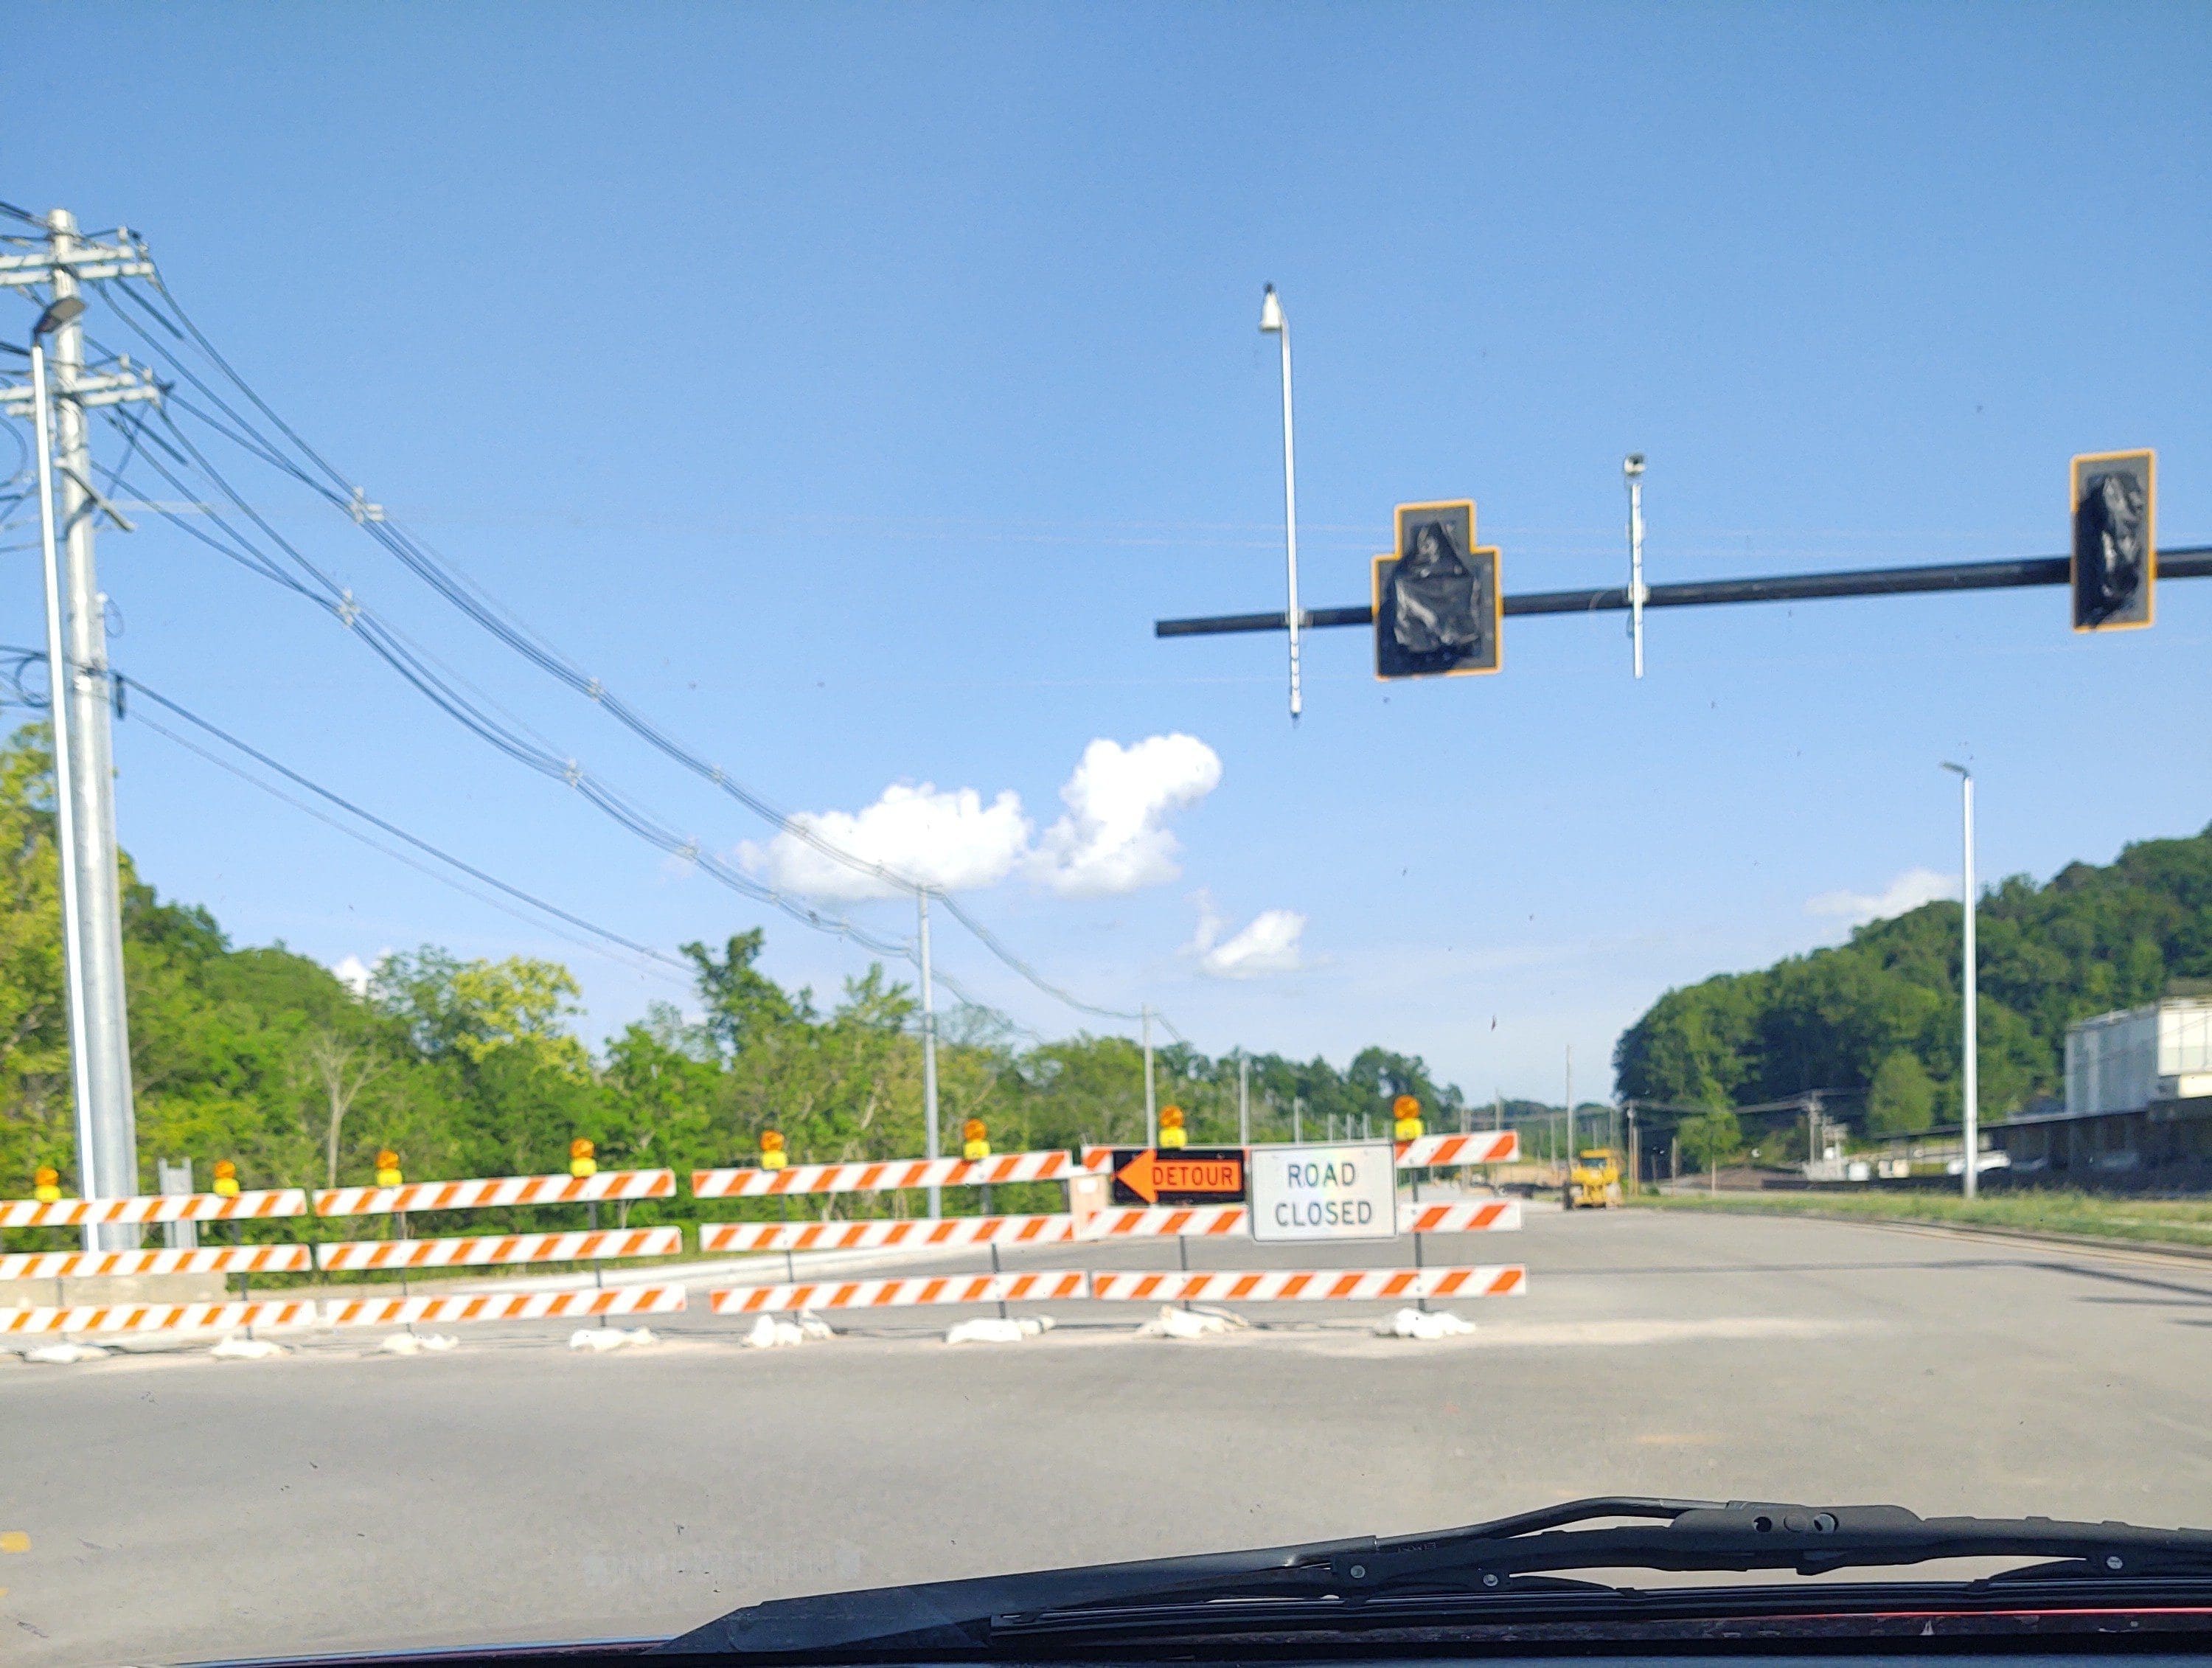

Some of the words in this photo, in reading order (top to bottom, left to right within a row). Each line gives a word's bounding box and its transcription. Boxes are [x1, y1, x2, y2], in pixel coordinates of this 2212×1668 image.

[1153, 1166, 1234, 1186] DETOUR
[1288, 1162, 1356, 1187] ROAD
[1276, 1201, 1372, 1226] CLOSED
